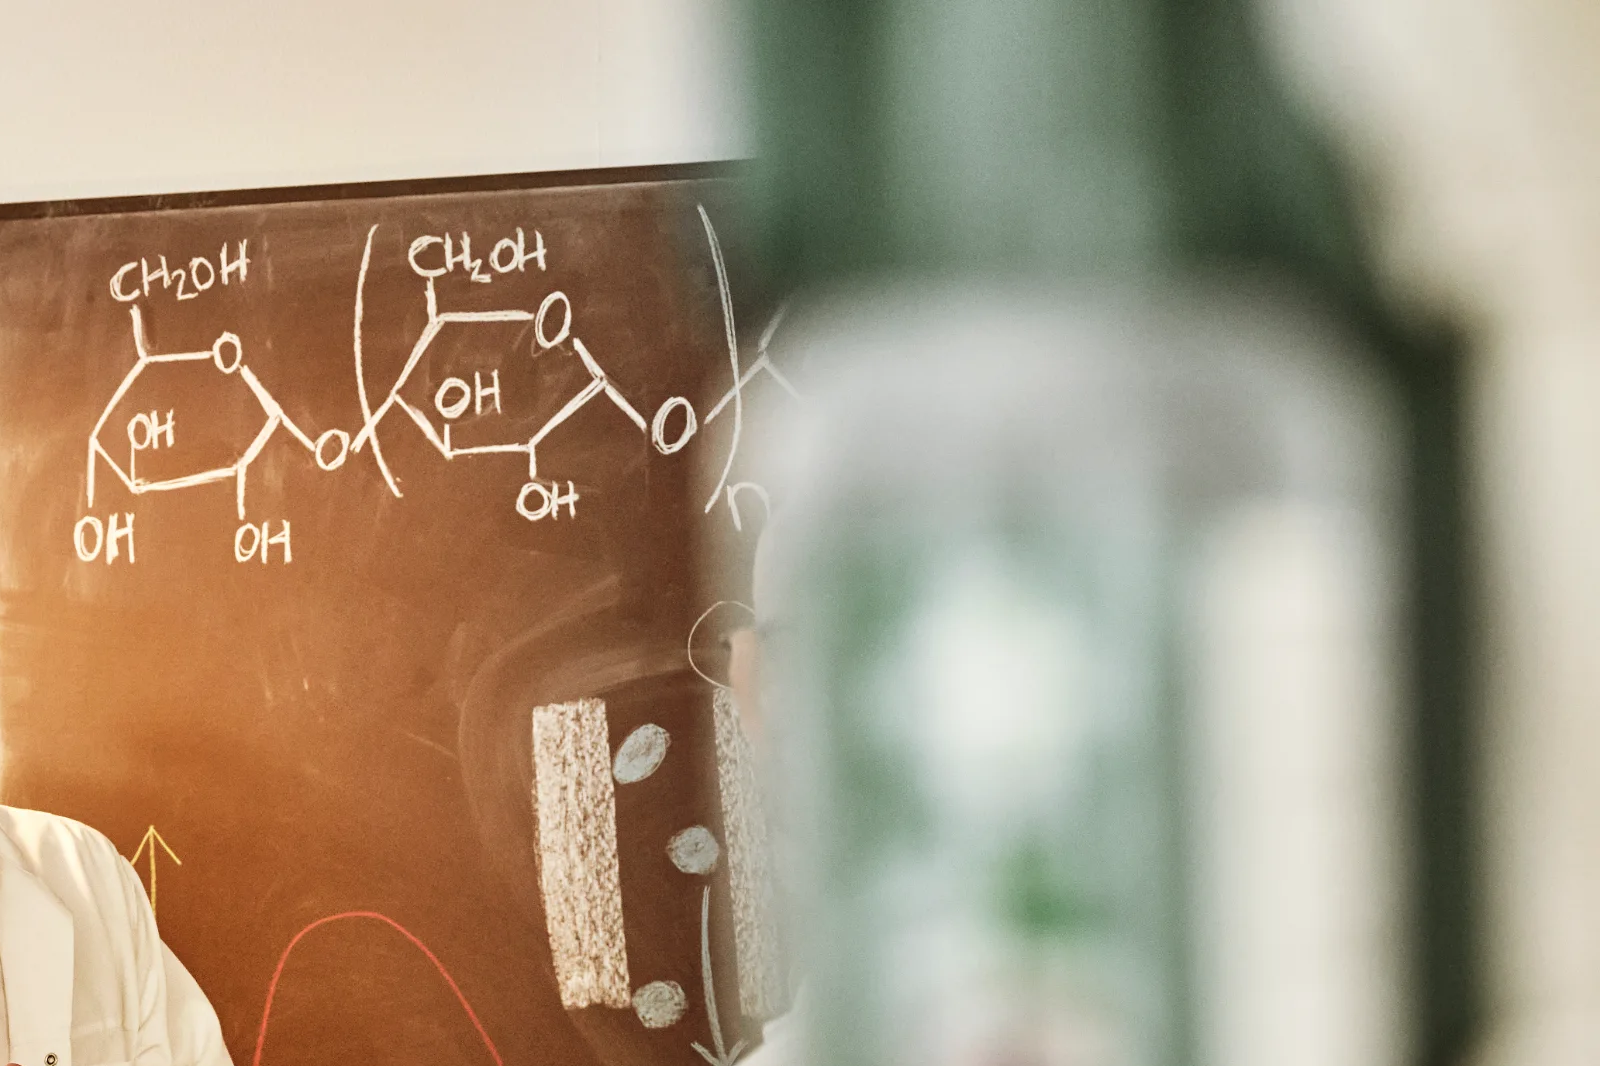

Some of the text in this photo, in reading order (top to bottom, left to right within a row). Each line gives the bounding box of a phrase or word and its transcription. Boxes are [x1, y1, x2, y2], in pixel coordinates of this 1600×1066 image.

[434, 369, 501, 419] OH
[127, 409, 175, 449] OH
[516, 480, 581, 521] OH
[73, 513, 136, 564] OH
[234, 520, 292, 564] OH
